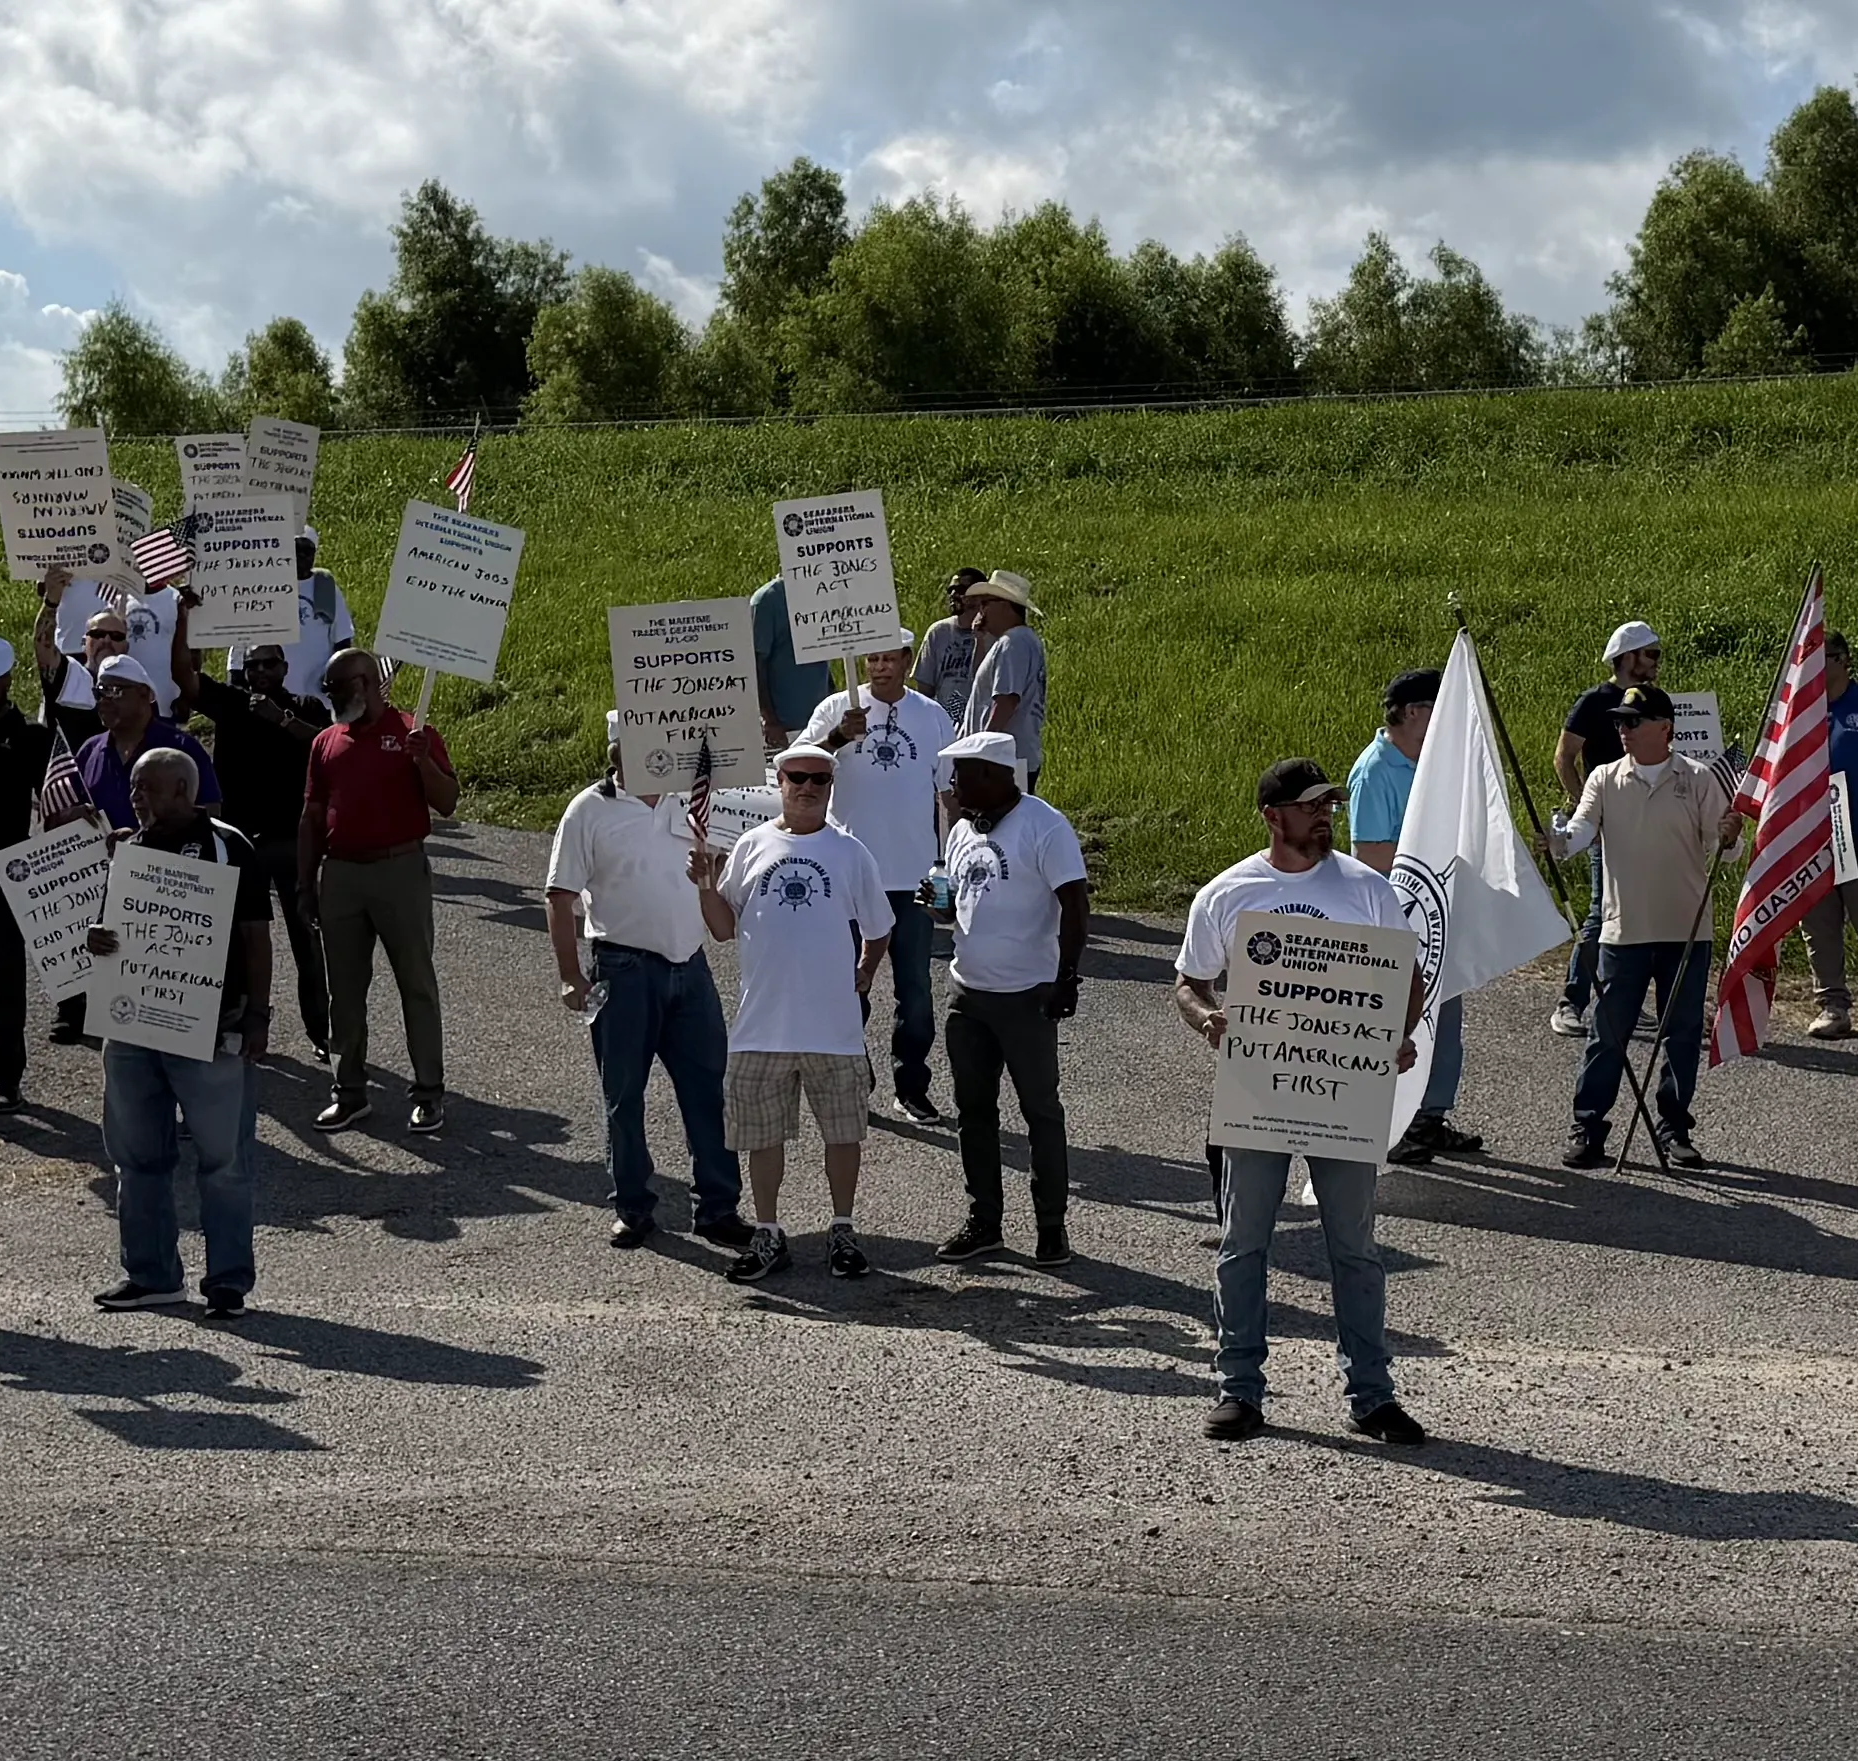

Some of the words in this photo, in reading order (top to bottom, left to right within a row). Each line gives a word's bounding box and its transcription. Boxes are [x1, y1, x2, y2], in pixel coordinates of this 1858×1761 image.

[260, 446, 308, 462] SUPPORTS
[74, 465, 104, 477] END
[33, 500, 108, 519] AMERICAN
[803, 505, 855, 519] SEAFARERS
[804, 512, 875, 528] INTERNATIONAL
[806, 524, 835, 536] UNION
[17, 525, 97, 539] SUPPORTS
[204, 538, 280, 552] SUPPORTS
[797, 536, 873, 558] SUPPORTS
[195, 559, 221, 572] THE
[265, 557, 293, 568] ACT
[408, 547, 470, 571] AMERICAN
[474, 568, 509, 586] JOBS
[787, 562, 825, 580] THE
[830, 557, 878, 577] JONES
[200, 584, 229, 601] PUT
[405, 575, 437, 592] END
[441, 584, 466, 598] THE
[815, 577, 854, 596] ACT
[234, 600, 275, 613] FIRST
[794, 610, 819, 627] PUT
[819, 603, 893, 624] AMERICANS
[649, 619, 666, 628] THE
[821, 619, 865, 637] FIRST
[633, 649, 735, 670] SUPPORTS
[626, 676, 666, 694] THE
[671, 676, 724, 695] JONES
[623, 708, 656, 727] PUT
[658, 704, 736, 725] AMERICANS
[666, 726, 721, 744] FIRST
[26, 833, 82, 860] SEAFARERS
[30, 833, 104, 868] INTERNATIONAL
[27, 859, 110, 900] SUPPORTS
[24, 899, 62, 924] THE
[123, 897, 213, 928] SUPPORTS
[33, 930, 63, 950] END
[66, 915, 94, 937] THE
[122, 922, 158, 940] THE
[164, 924, 213, 946] JONES
[145, 944, 185, 958] ACT
[1285, 933, 1369, 954] SEAFARERS
[120, 959, 149, 976] PUT
[1282, 959, 1328, 973] UNION
[1283, 946, 1399, 970] INTERNATIONAL
[141, 986, 187, 1005] FIRST
[1257, 979, 1384, 1009] SUPPORTS
[1230, 1005, 1281, 1025] THE
[1287, 1012, 1350, 1035] JONES
[1353, 1023, 1397, 1042] ACT
[1227, 1036, 1274, 1059] PUT
[1272, 1042, 1390, 1076] AMERICANS
[1272, 1073, 1348, 1101] FIRST
